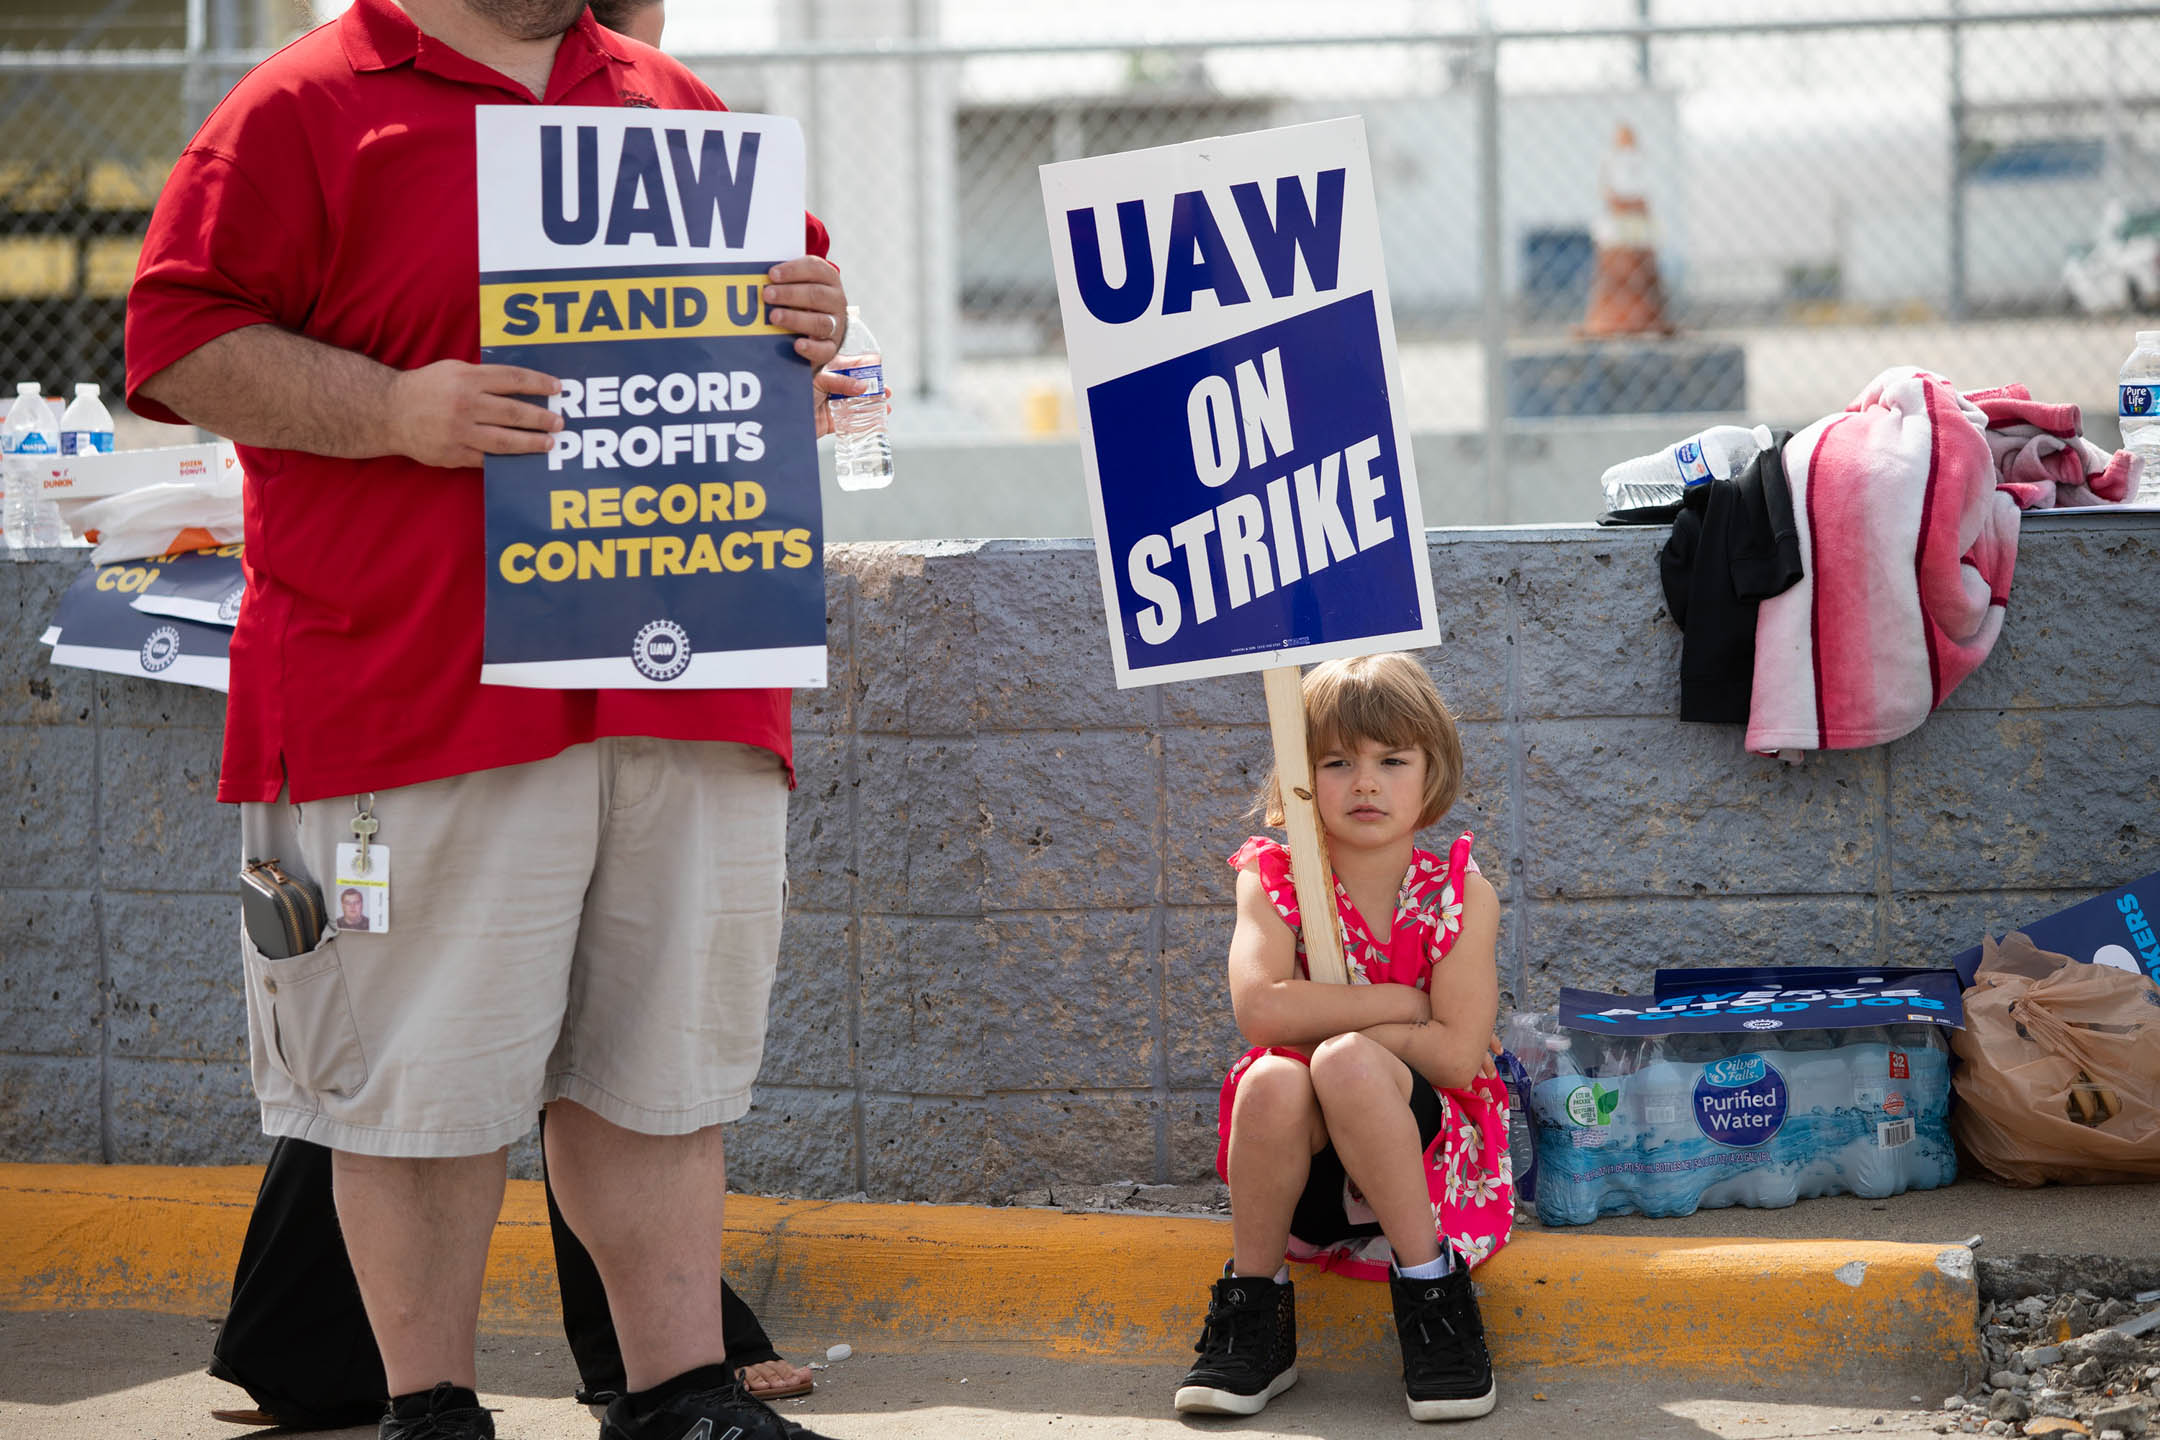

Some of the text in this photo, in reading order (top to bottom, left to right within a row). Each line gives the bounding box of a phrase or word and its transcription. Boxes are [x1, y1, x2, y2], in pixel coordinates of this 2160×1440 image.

[540, 125, 761, 249] UAW
[1066, 167, 1346, 324] UAW
[502, 284, 772, 336] STAND U
[547, 370, 762, 419] RECORD
[2126, 386, 2147, 396] Pure
[2128, 395, 2144, 406] Life
[1187, 346, 1293, 488] ON
[547, 420, 766, 471] PROFITS
[550, 480, 767, 530] RECORD
[1128, 434, 1396, 647] STRIKE
[498, 527, 814, 585] CONTRACTS
[650, 643, 674, 656] UAW
[1597, 998, 1776, 1016] AUTO
[1636, 1001, 1812, 1021] GOOD
[1827, 997, 1945, 1010] JOB
[1708, 1058, 1761, 1084] Silver
[1893, 1053, 1905, 1068] 32
[1728, 1069, 1755, 1082] Falls
[1702, 1087, 1777, 1113] Purified
[1709, 1112, 1773, 1132] Water
